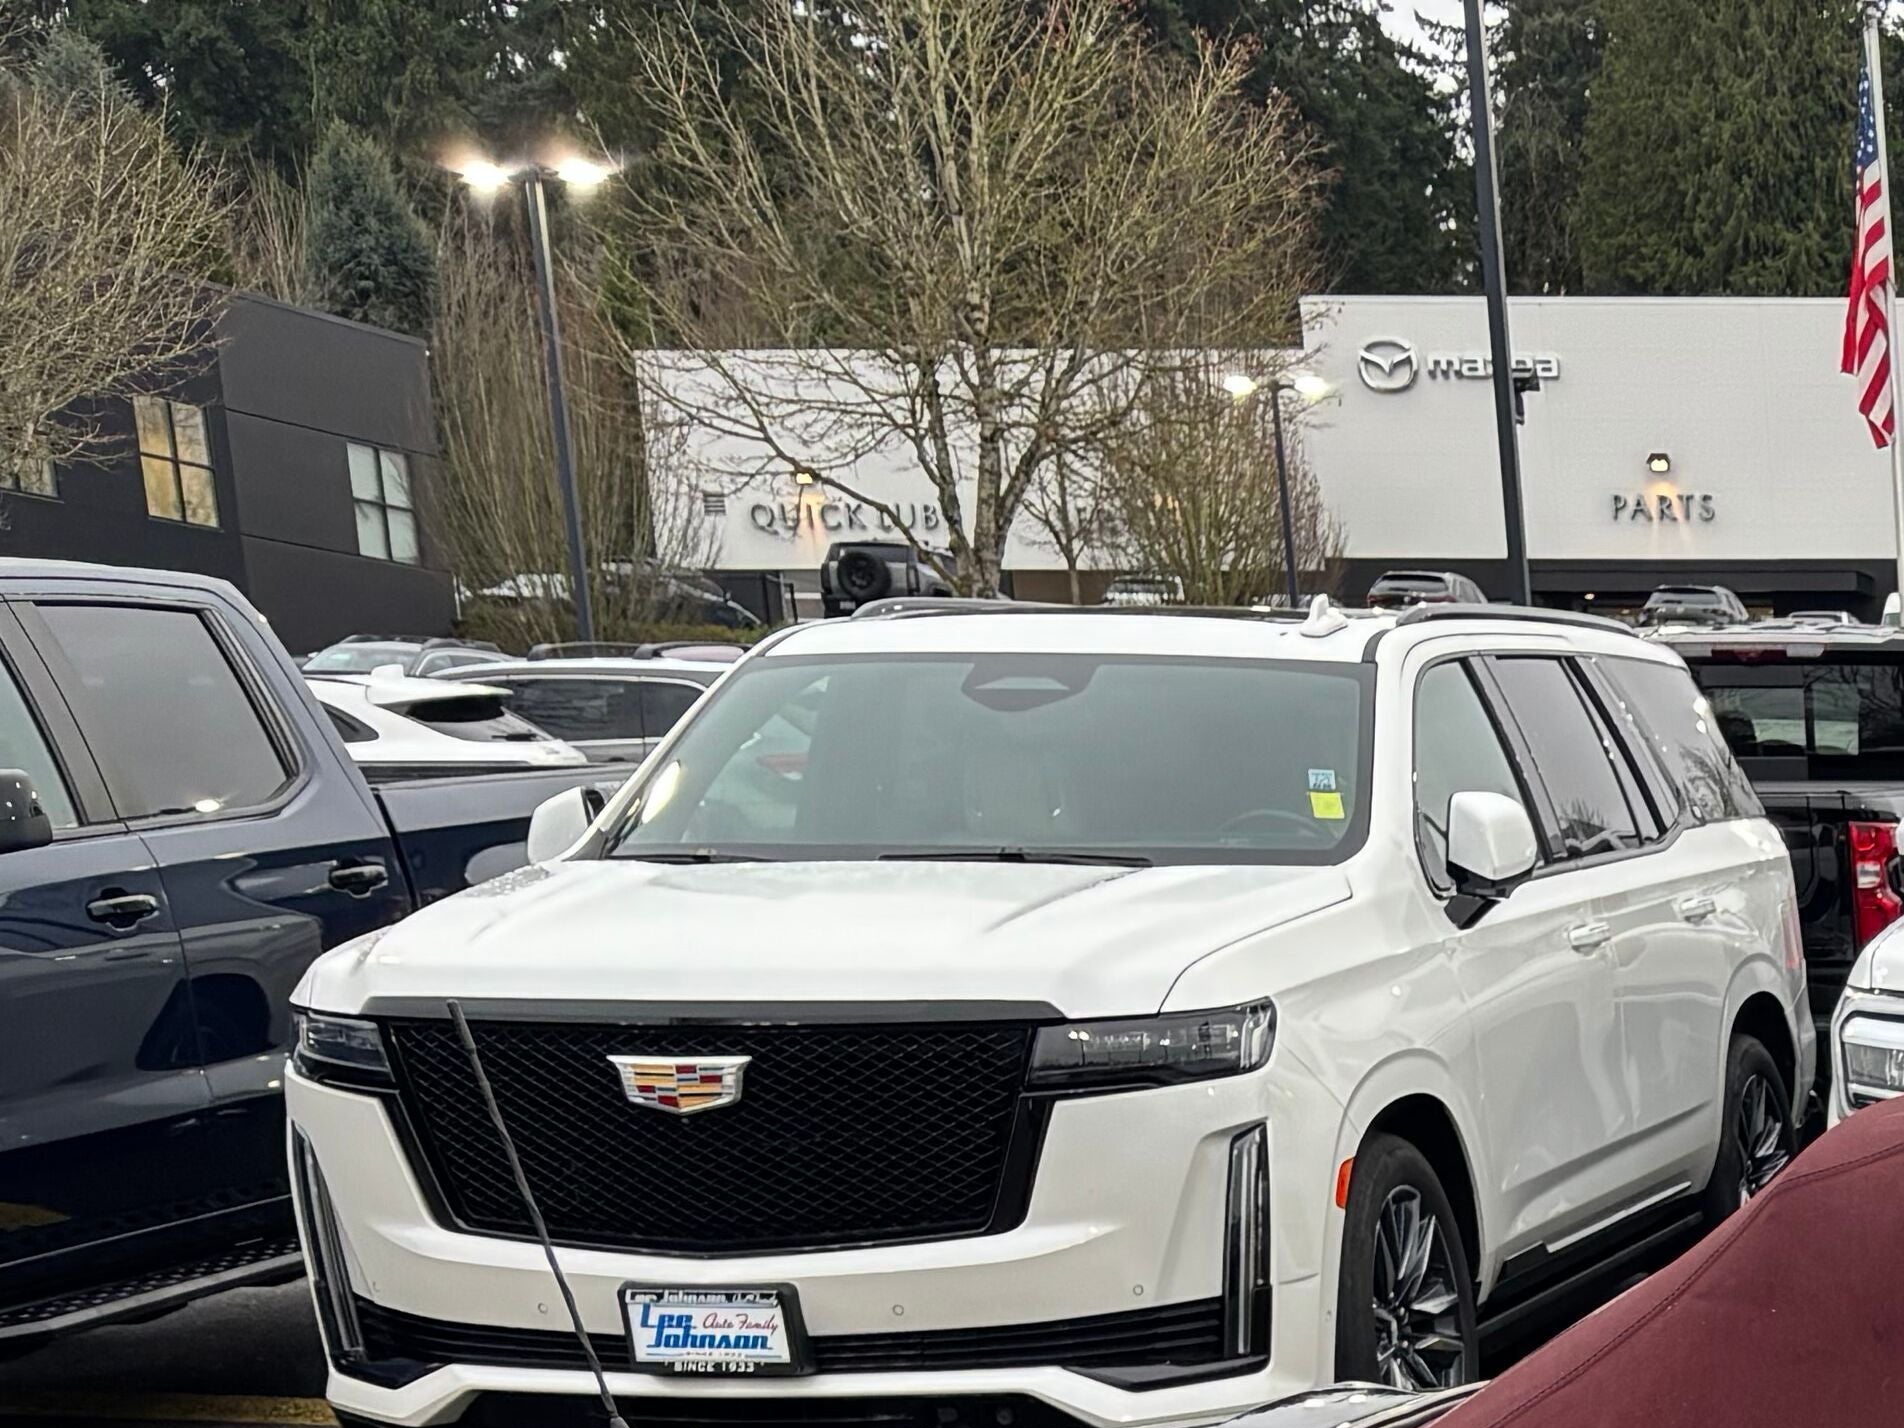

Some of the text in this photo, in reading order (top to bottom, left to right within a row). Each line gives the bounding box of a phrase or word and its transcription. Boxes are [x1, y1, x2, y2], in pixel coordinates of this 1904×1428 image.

[1426, 351, 1561, 381] mada
[750, 501, 942, 537] QUICK LUB
[1611, 493, 1717, 523] PARTS
[640, 1301, 779, 1336] Lee Auto Family
[646, 1325, 774, 1350] Johnson
[673, 1361, 755, 1373] SINCE 1933
